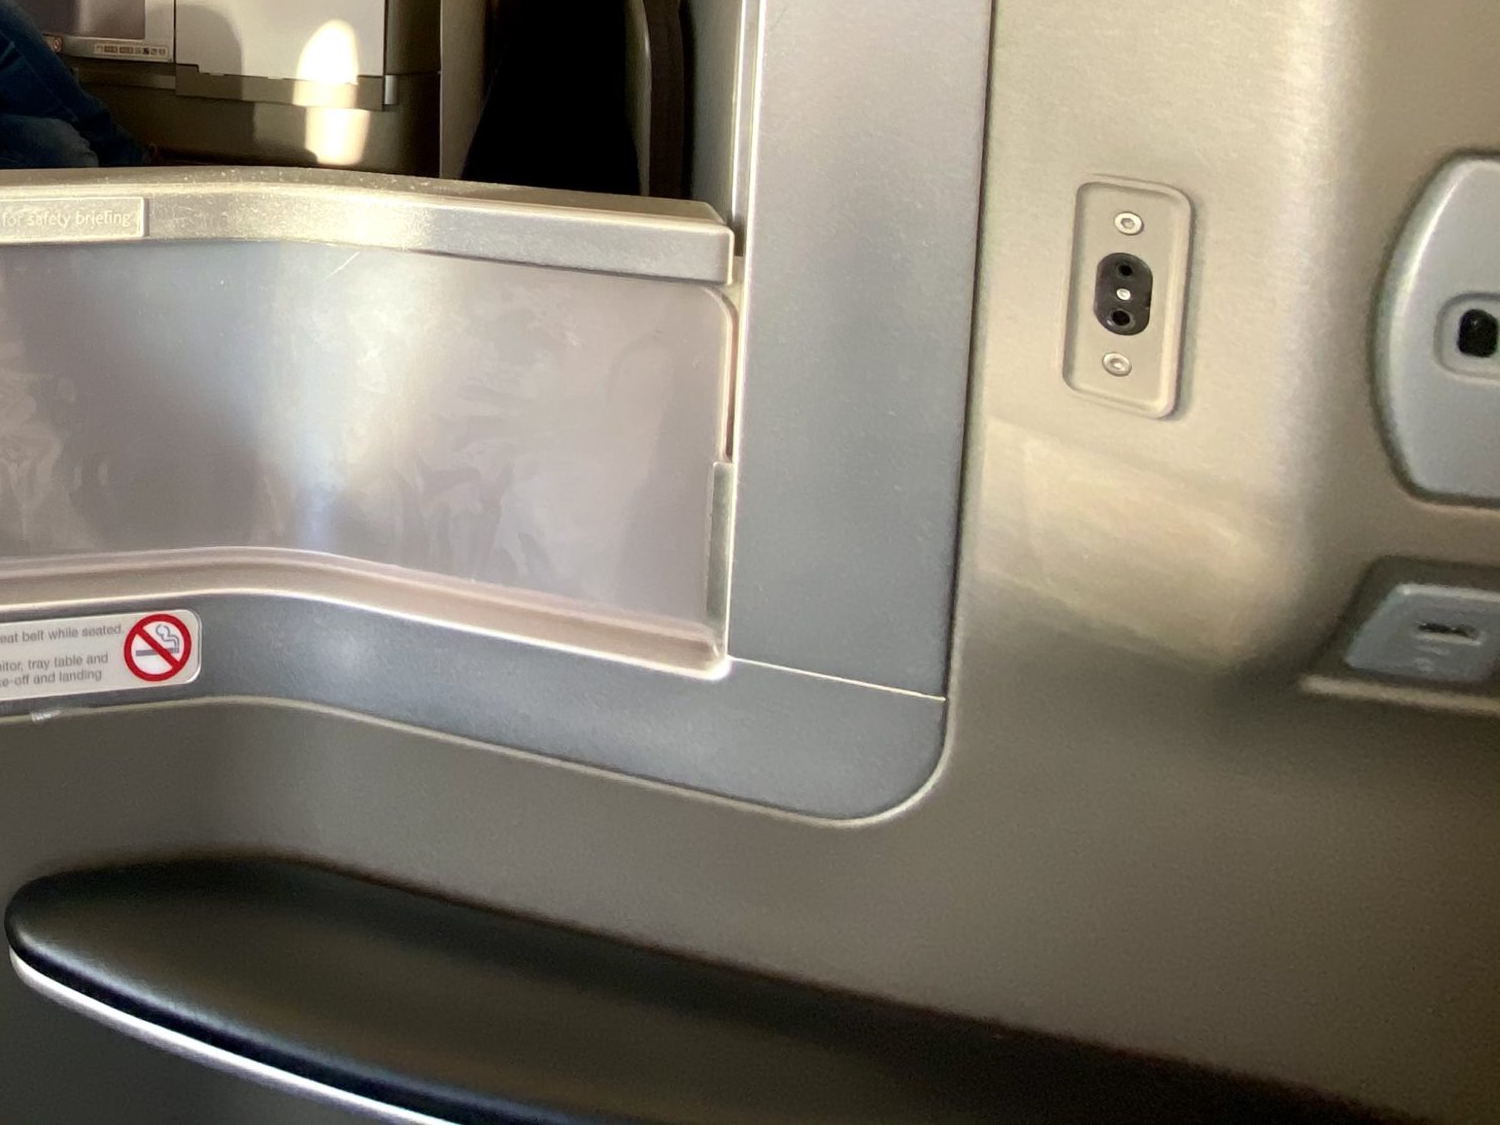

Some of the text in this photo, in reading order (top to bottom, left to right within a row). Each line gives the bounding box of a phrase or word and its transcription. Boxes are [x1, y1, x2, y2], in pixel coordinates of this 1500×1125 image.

[2, 210, 25, 228] for
[27, 211, 71, 227] safety
[75, 209, 132, 227] briefing
[22, 631, 44, 643] belt
[48, 627, 78, 640] while
[82, 623, 124, 636] seated.
[28, 658, 51, 671] tray
[54, 655, 83, 668] table
[86, 652, 109, 664] and
[33, 671, 56, 684] and
[59, 668, 102, 683] landing
